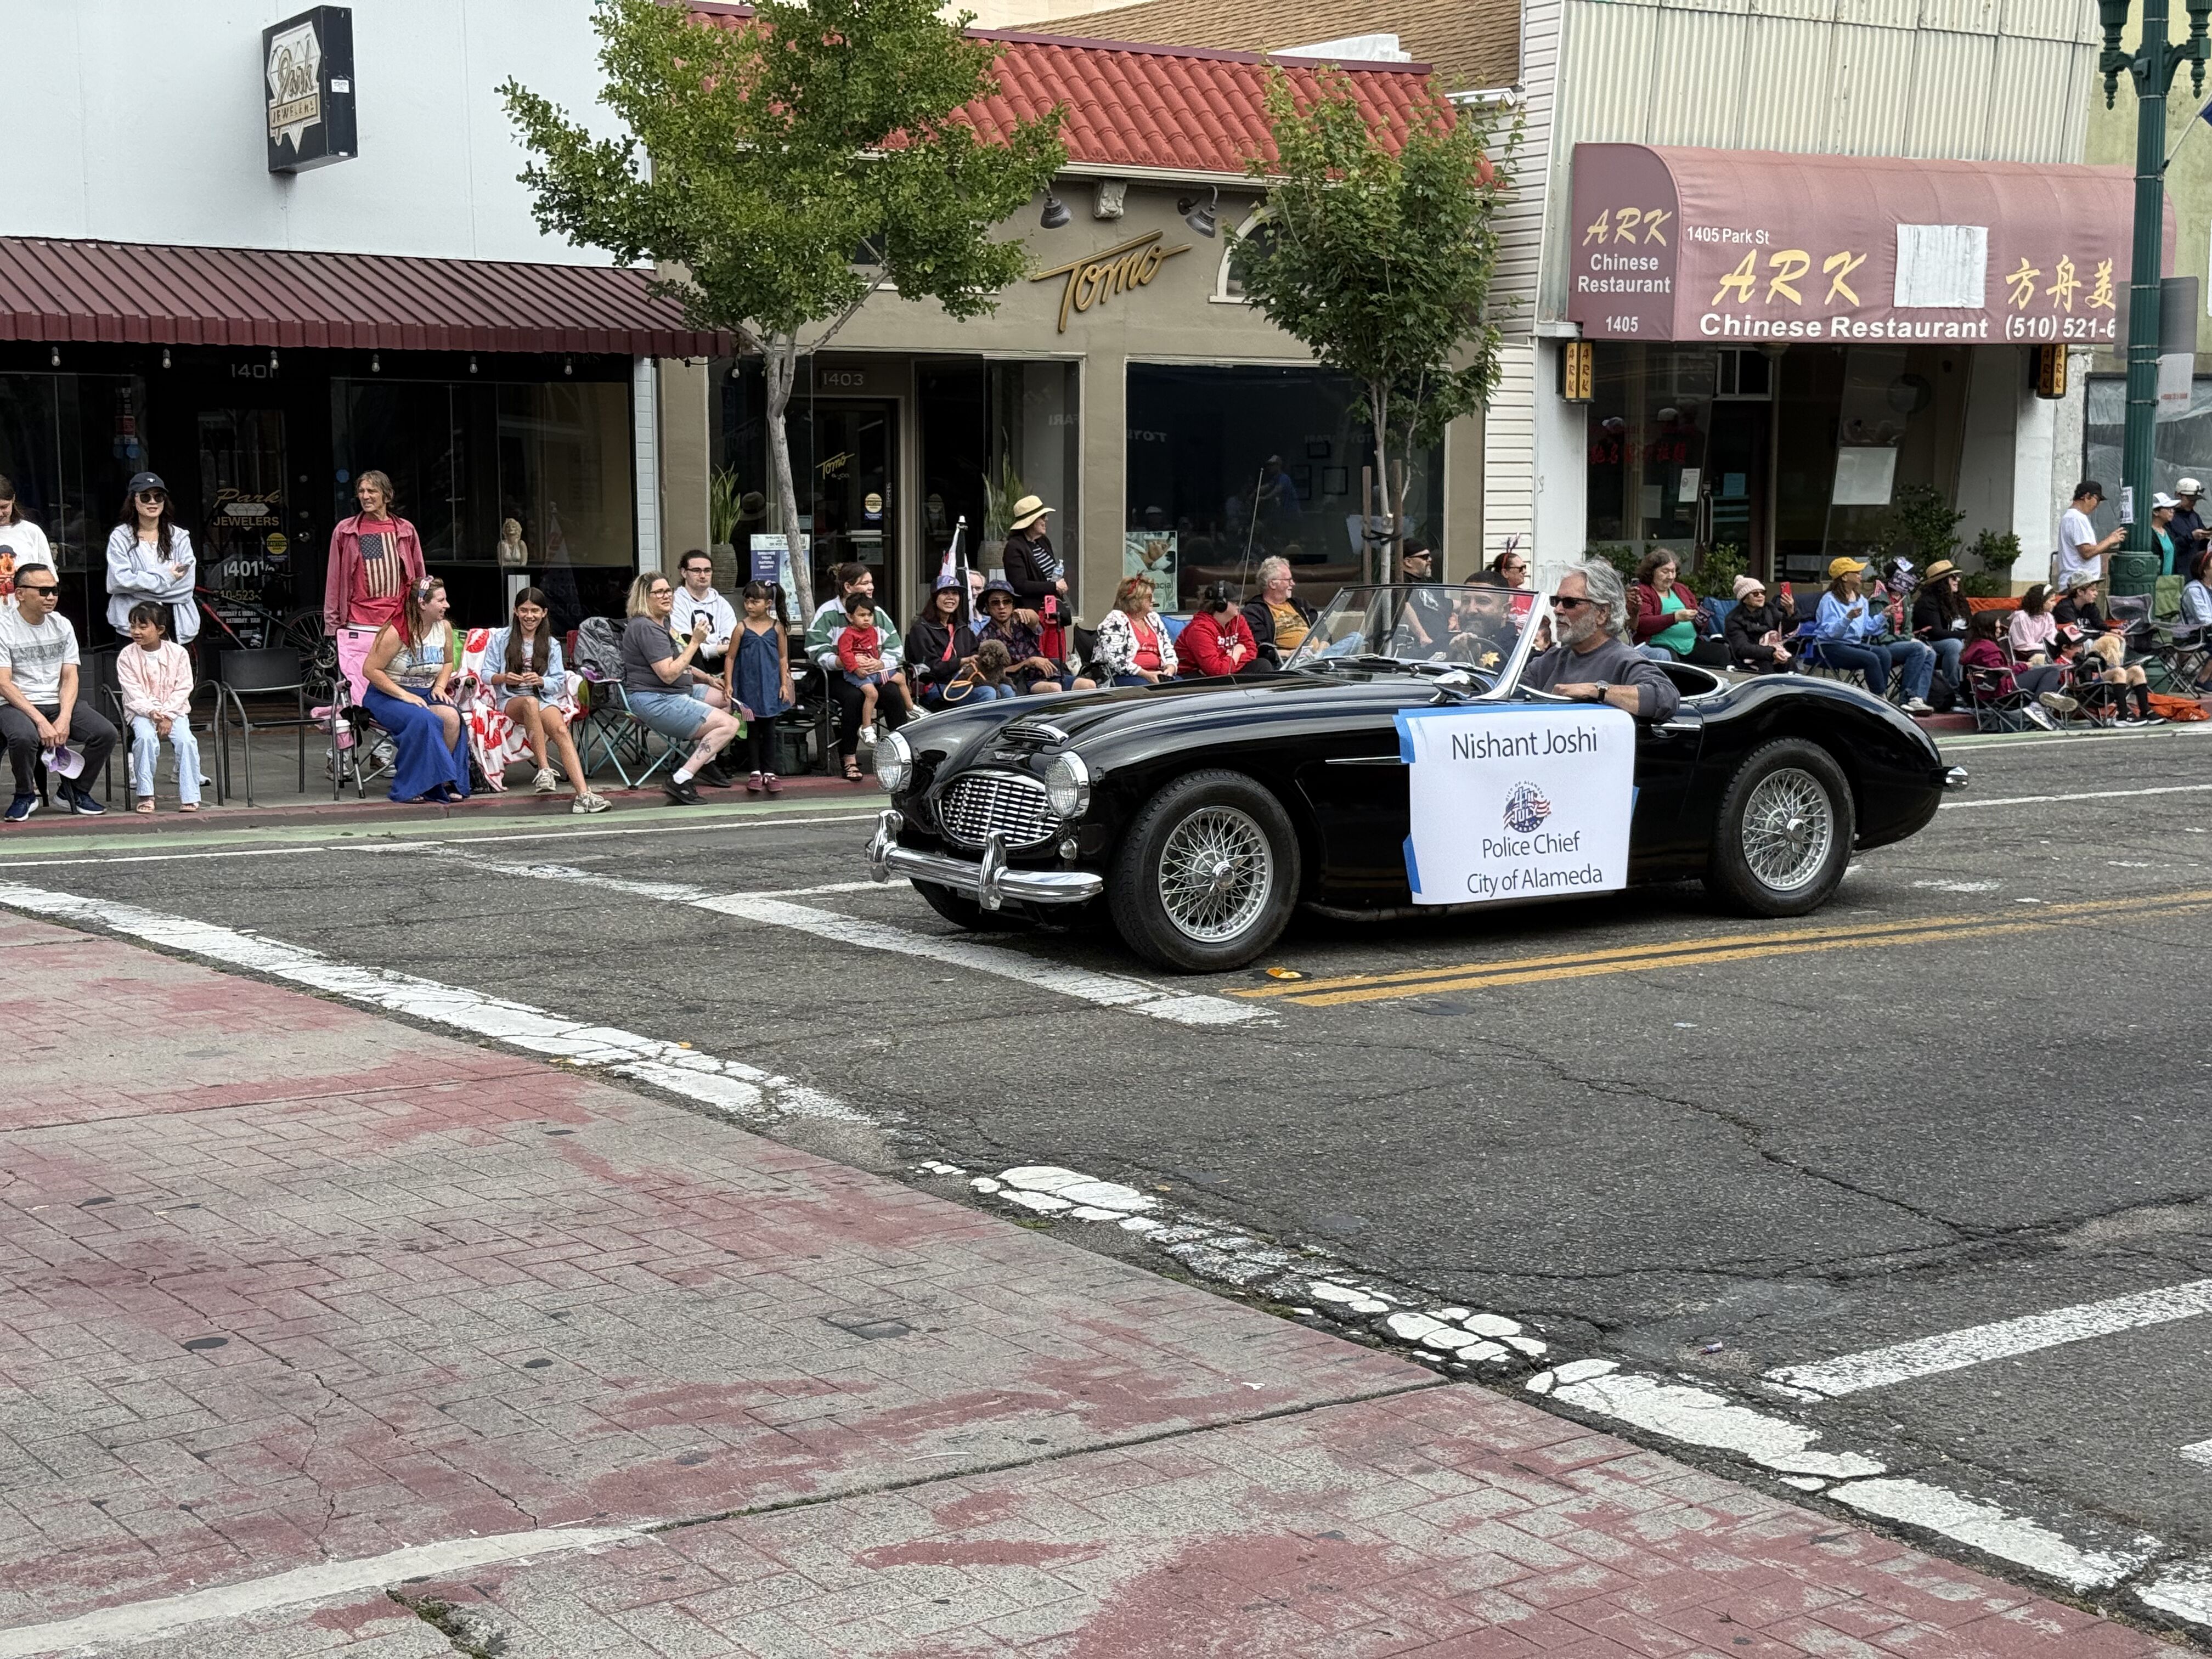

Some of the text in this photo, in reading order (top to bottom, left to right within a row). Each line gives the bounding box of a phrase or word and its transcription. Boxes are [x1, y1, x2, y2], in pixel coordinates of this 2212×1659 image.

[1582, 208, 1672, 246] ARK
[1687, 226, 1770, 245] 1405 Park St
[1591, 253, 1659, 271] Chinese
[1029, 229, 1193, 332] Tomo
[1578, 275, 1671, 294] Restaurant
[1712, 249, 1867, 307] ARK
[1606, 315, 1639, 332] 1405
[1700, 313, 1822, 338] Chinese
[1831, 316, 1989, 338] Restaurant
[2005, 314, 2057, 341] (510)
[823, 373, 864, 386] 1403
[1582, 348, 1590, 392] ARK
[815, 451, 855, 480] Tomo
[213, 488, 281, 509] Park
[213, 516, 280, 527] JEWELERS
[1452, 726, 1597, 760] Nishant Joshi
[1511, 803, 1538, 824] JULY
[1482, 831, 1581, 859] Police Chief
[1468, 863, 1603, 898] City of Alameda
